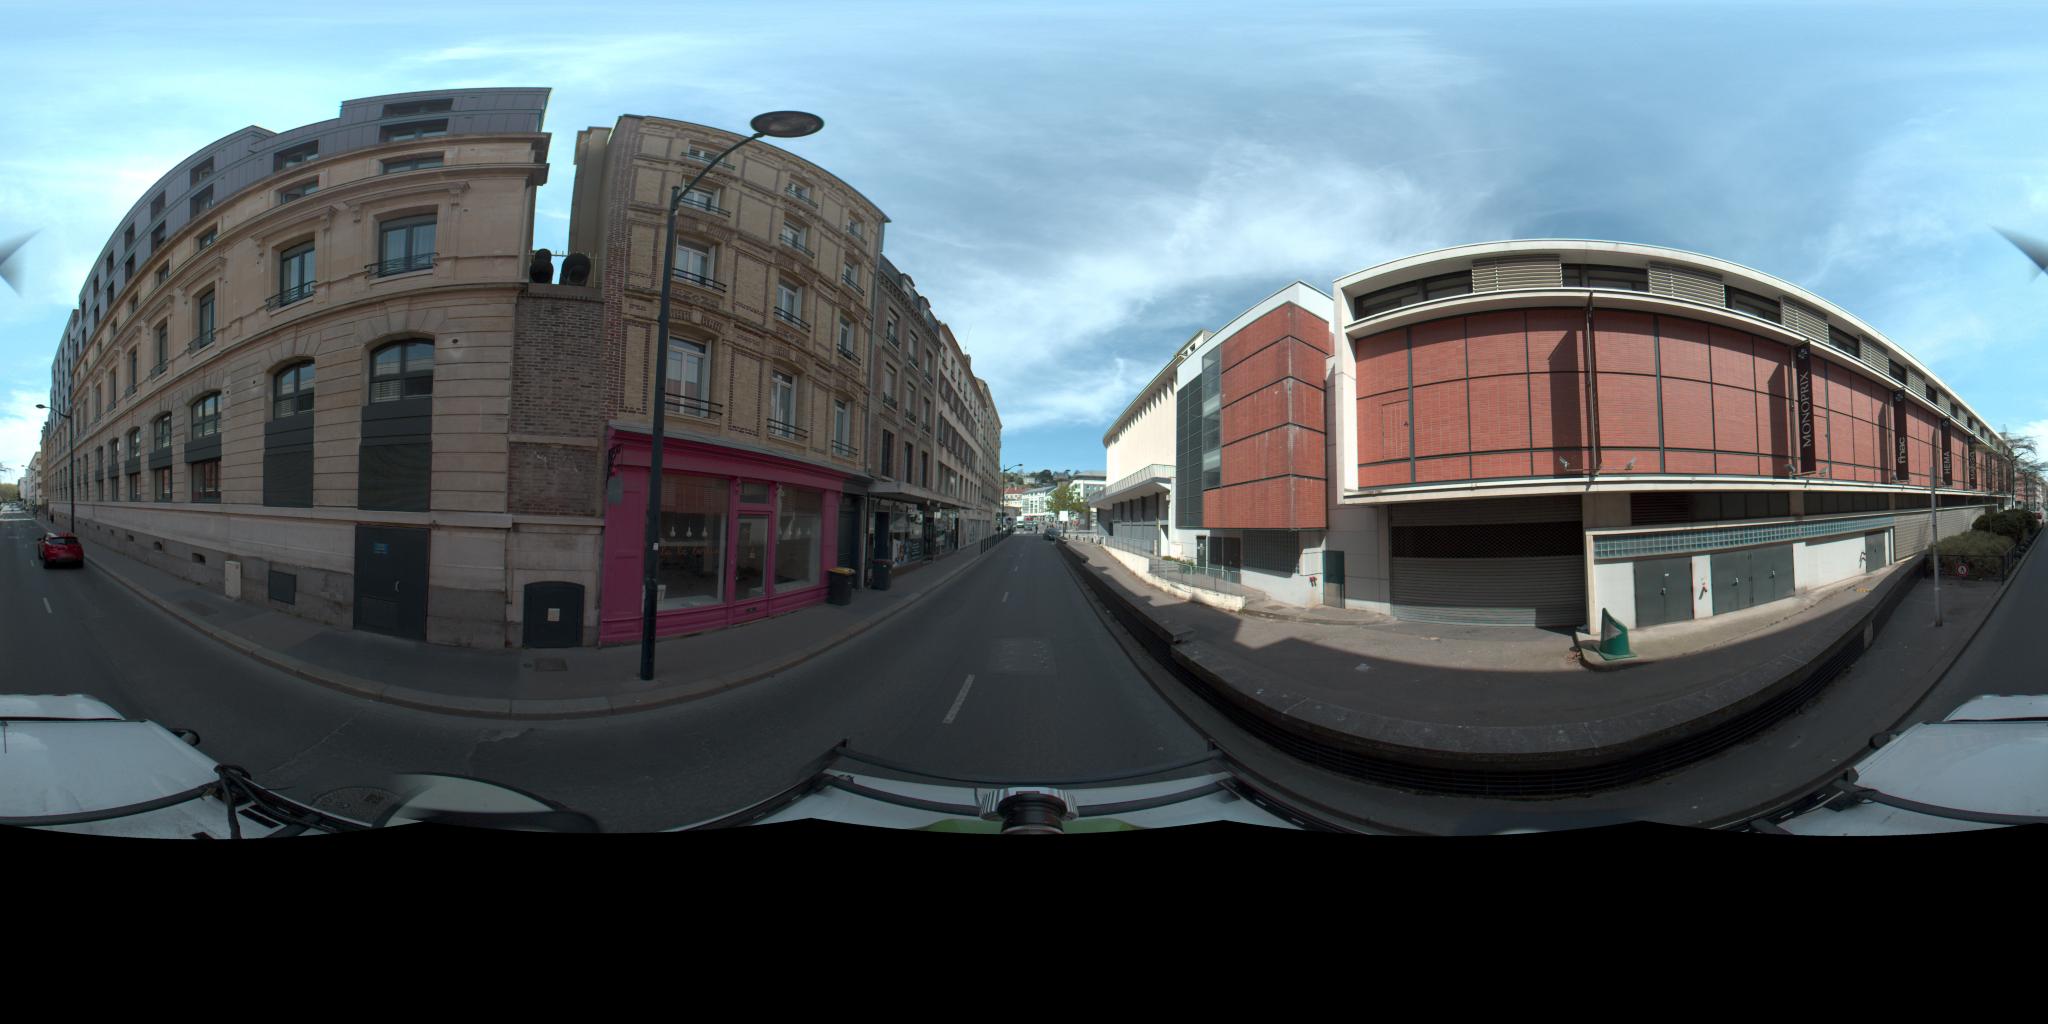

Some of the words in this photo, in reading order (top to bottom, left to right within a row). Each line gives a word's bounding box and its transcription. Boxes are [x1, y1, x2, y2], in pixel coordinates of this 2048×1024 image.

[1800, 370, 1812, 448] MONOPRIX
[1897, 436, 1906, 465] fnac
[1943, 450, 1951, 474] HEMA
